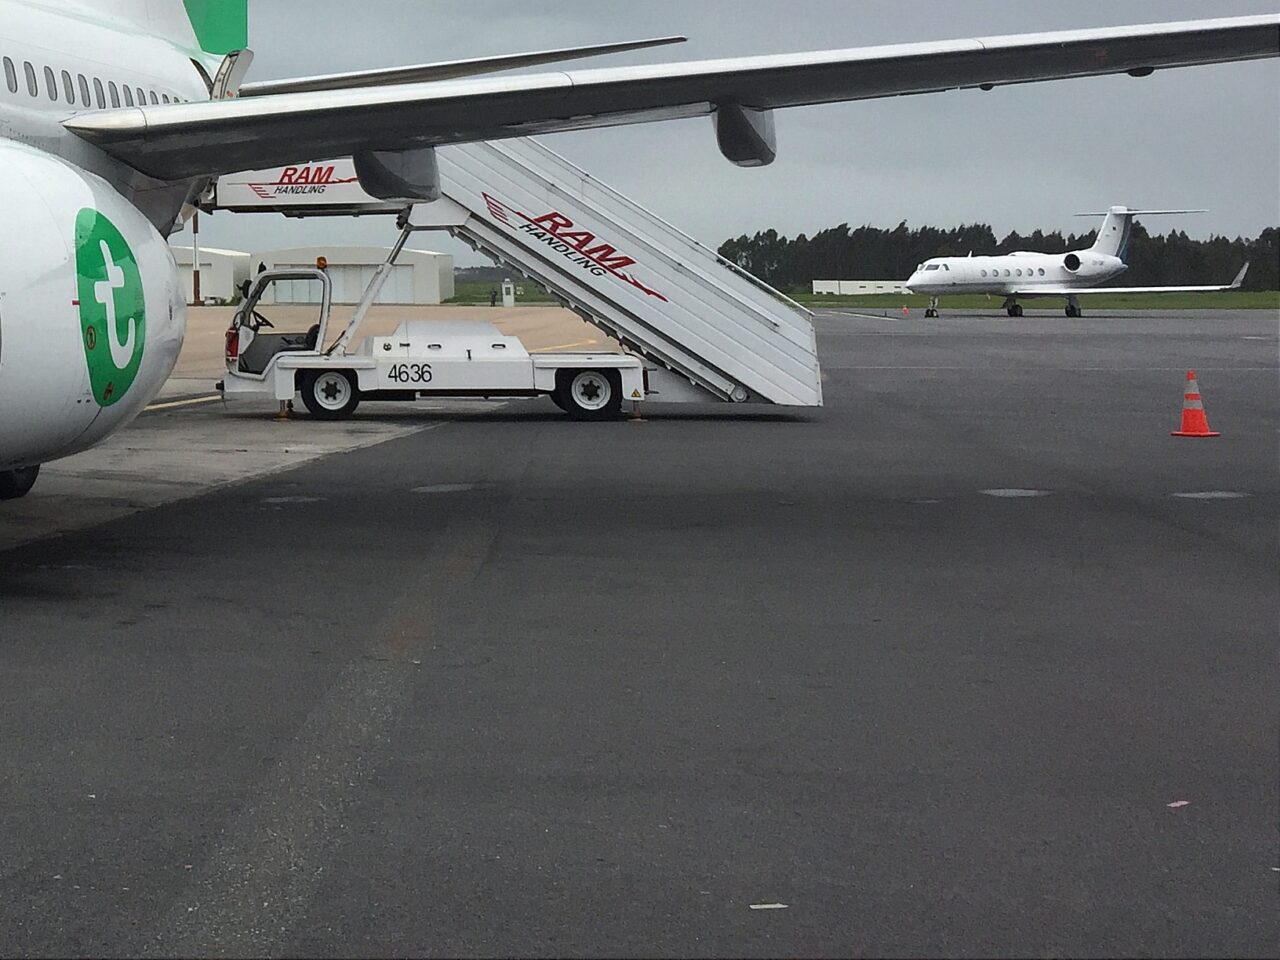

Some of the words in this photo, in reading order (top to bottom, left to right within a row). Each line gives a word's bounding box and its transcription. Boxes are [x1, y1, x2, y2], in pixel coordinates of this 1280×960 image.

[273, 185, 327, 194] HANDLING
[278, 166, 335, 183] RAM
[519, 223, 607, 277] HANDLING
[532, 211, 637, 274] RAM
[94, 239, 136, 369] t
[387, 363, 432, 382] 4636
